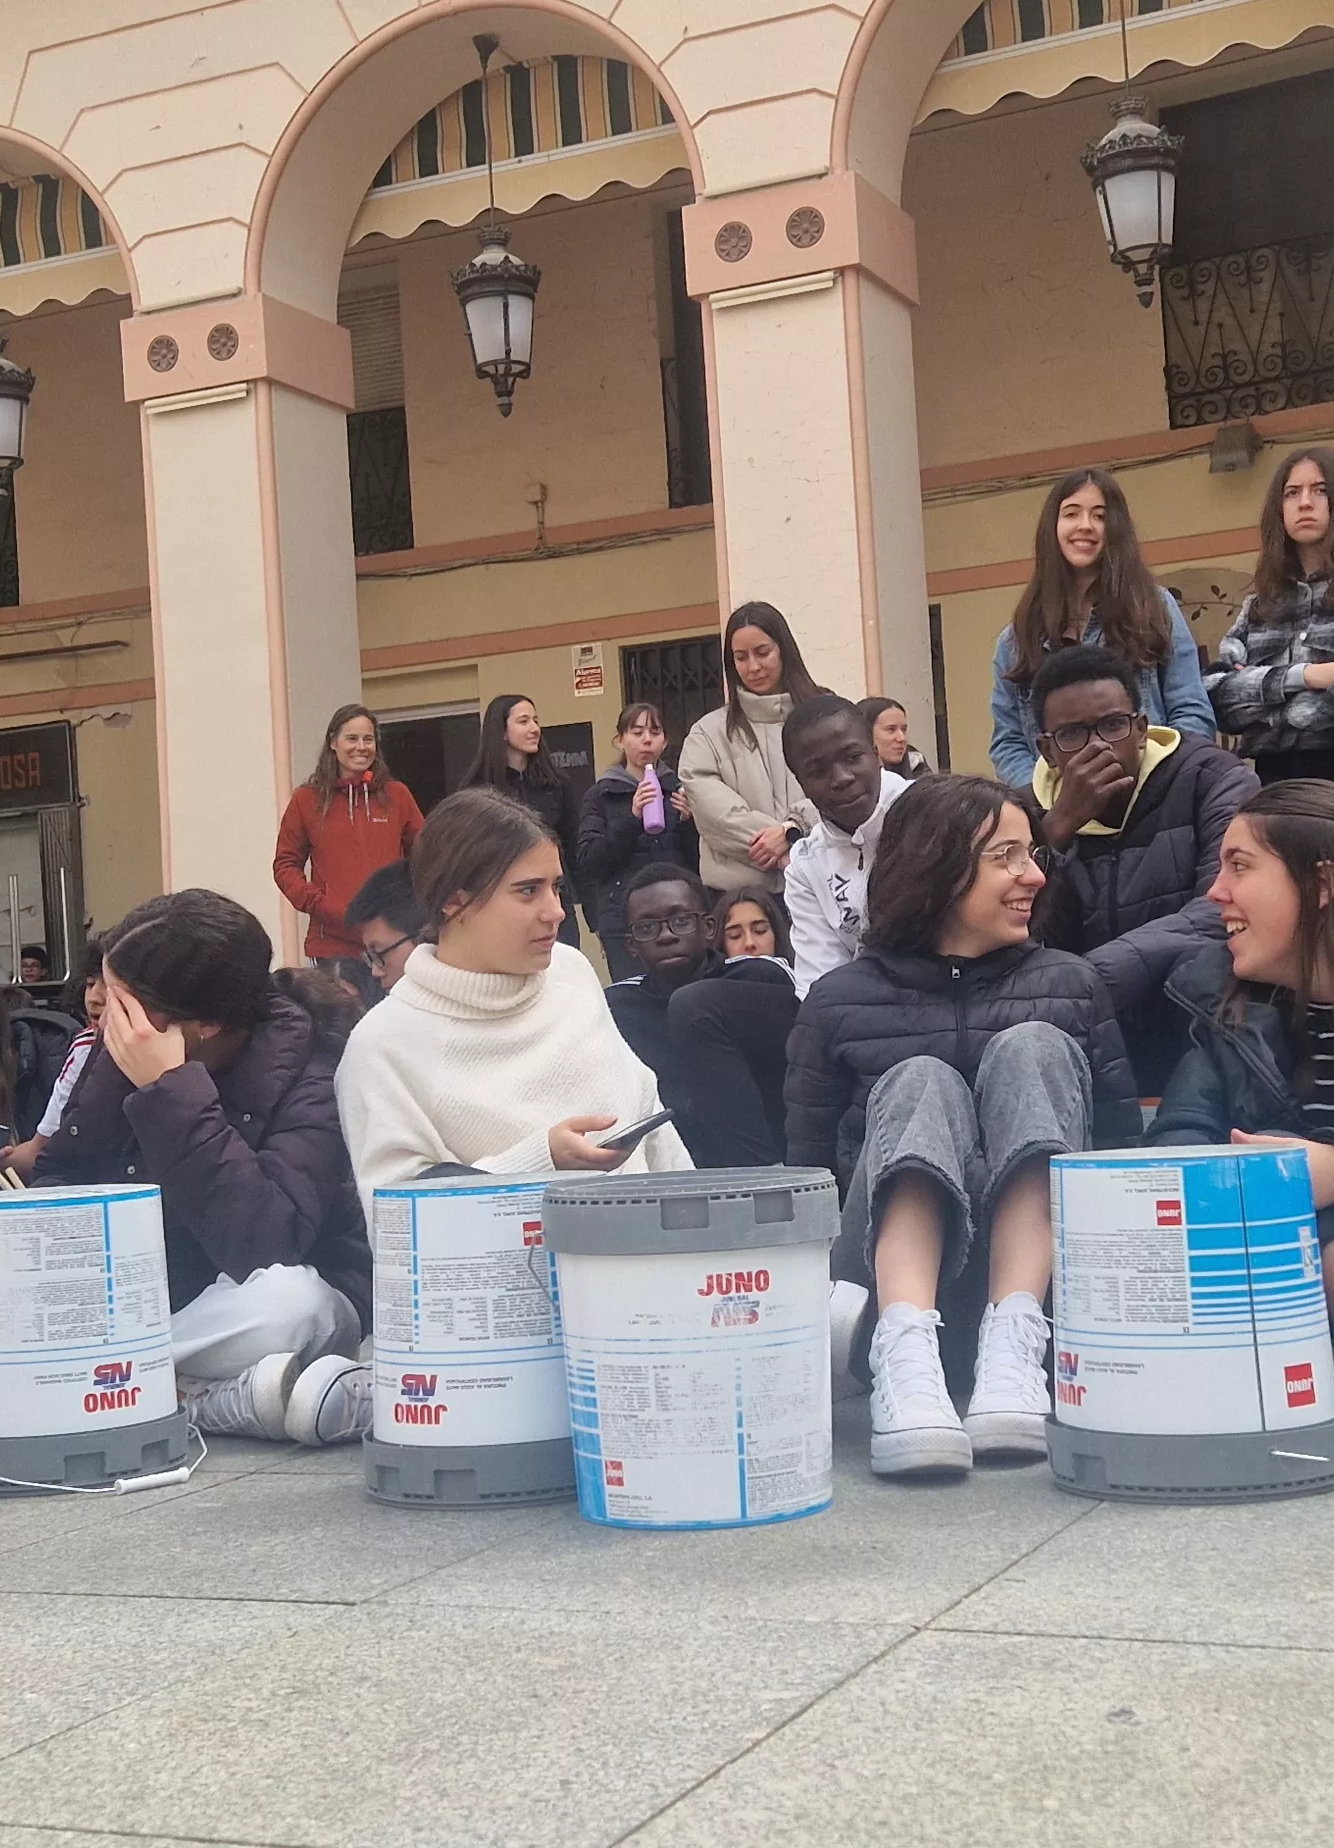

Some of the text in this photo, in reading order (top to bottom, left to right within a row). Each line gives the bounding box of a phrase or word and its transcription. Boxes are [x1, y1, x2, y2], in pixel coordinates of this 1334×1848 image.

[1157, 1209, 1181, 1218] JUNO
[697, 1269, 770, 1297] JUNO
[93, 1361, 133, 1386] N5
[401, 1374, 438, 1396] N5
[1057, 1380, 1087, 1406] JUN
[1286, 1378, 1313, 1393] JUNO
[84, 1387, 141, 1413] JUNO
[394, 1403, 448, 1425] JUNO
